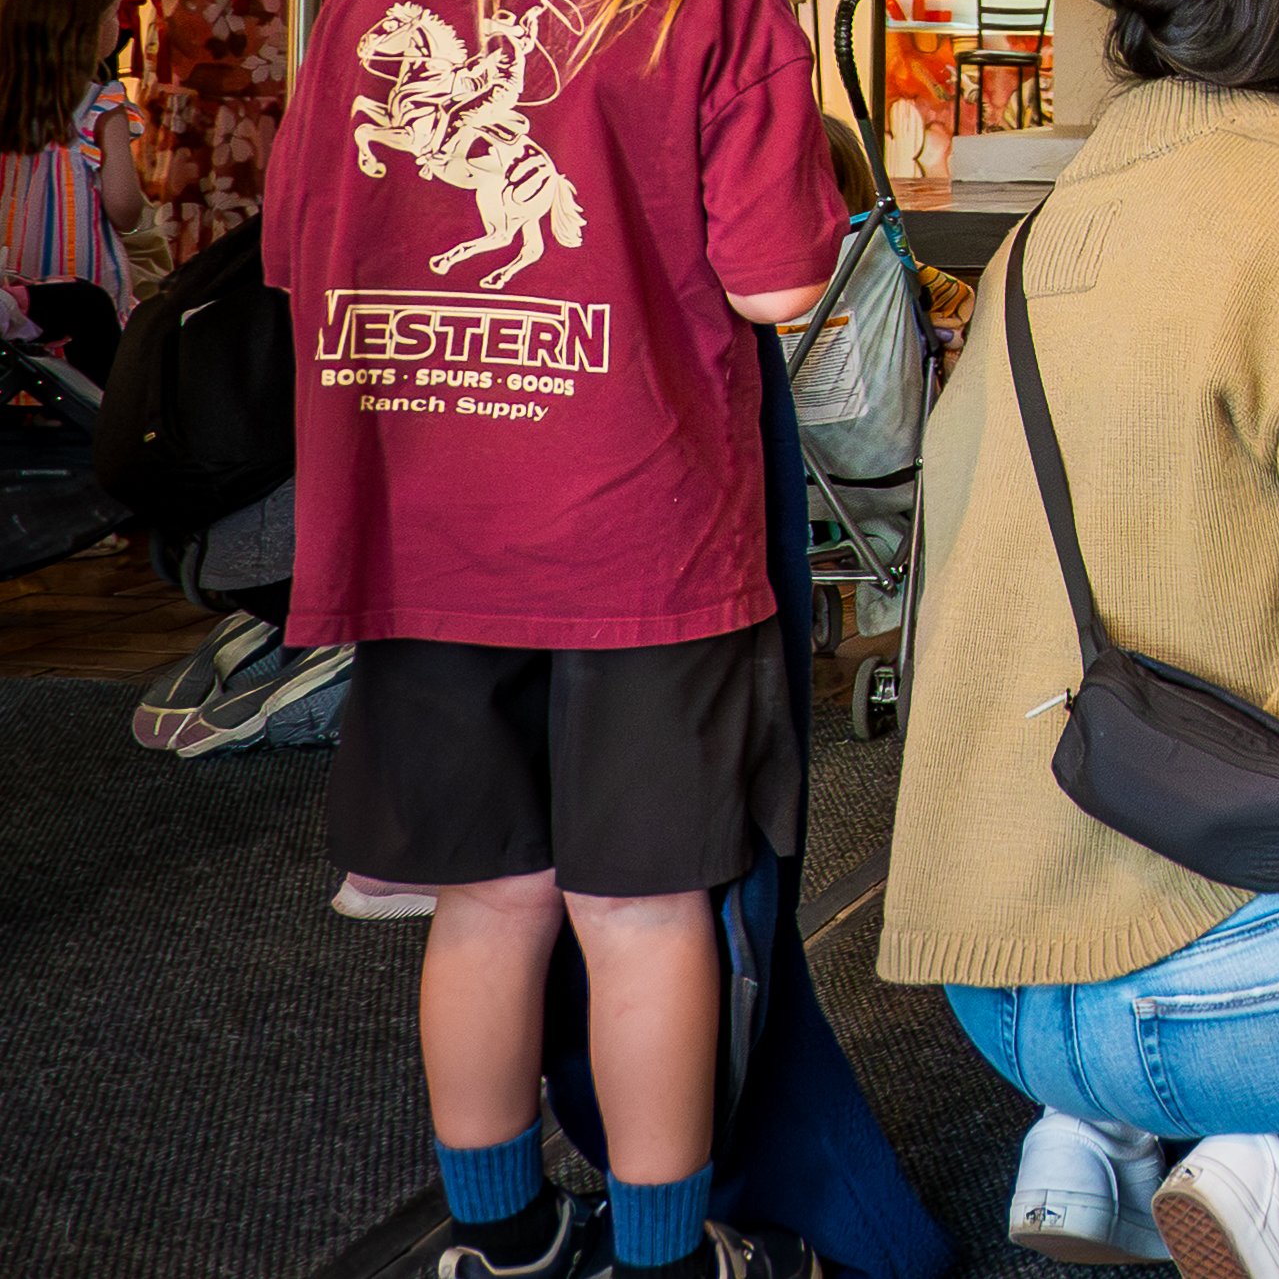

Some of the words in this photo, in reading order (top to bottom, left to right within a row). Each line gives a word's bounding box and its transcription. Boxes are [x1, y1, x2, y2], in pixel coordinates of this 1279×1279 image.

[320, 369, 396, 387] BOOTS
[415, 371, 493, 389] SPURS
[506, 374, 576, 396] GOODS
[360, 394, 445, 413] Ranch
[455, 397, 550, 423] Supply
